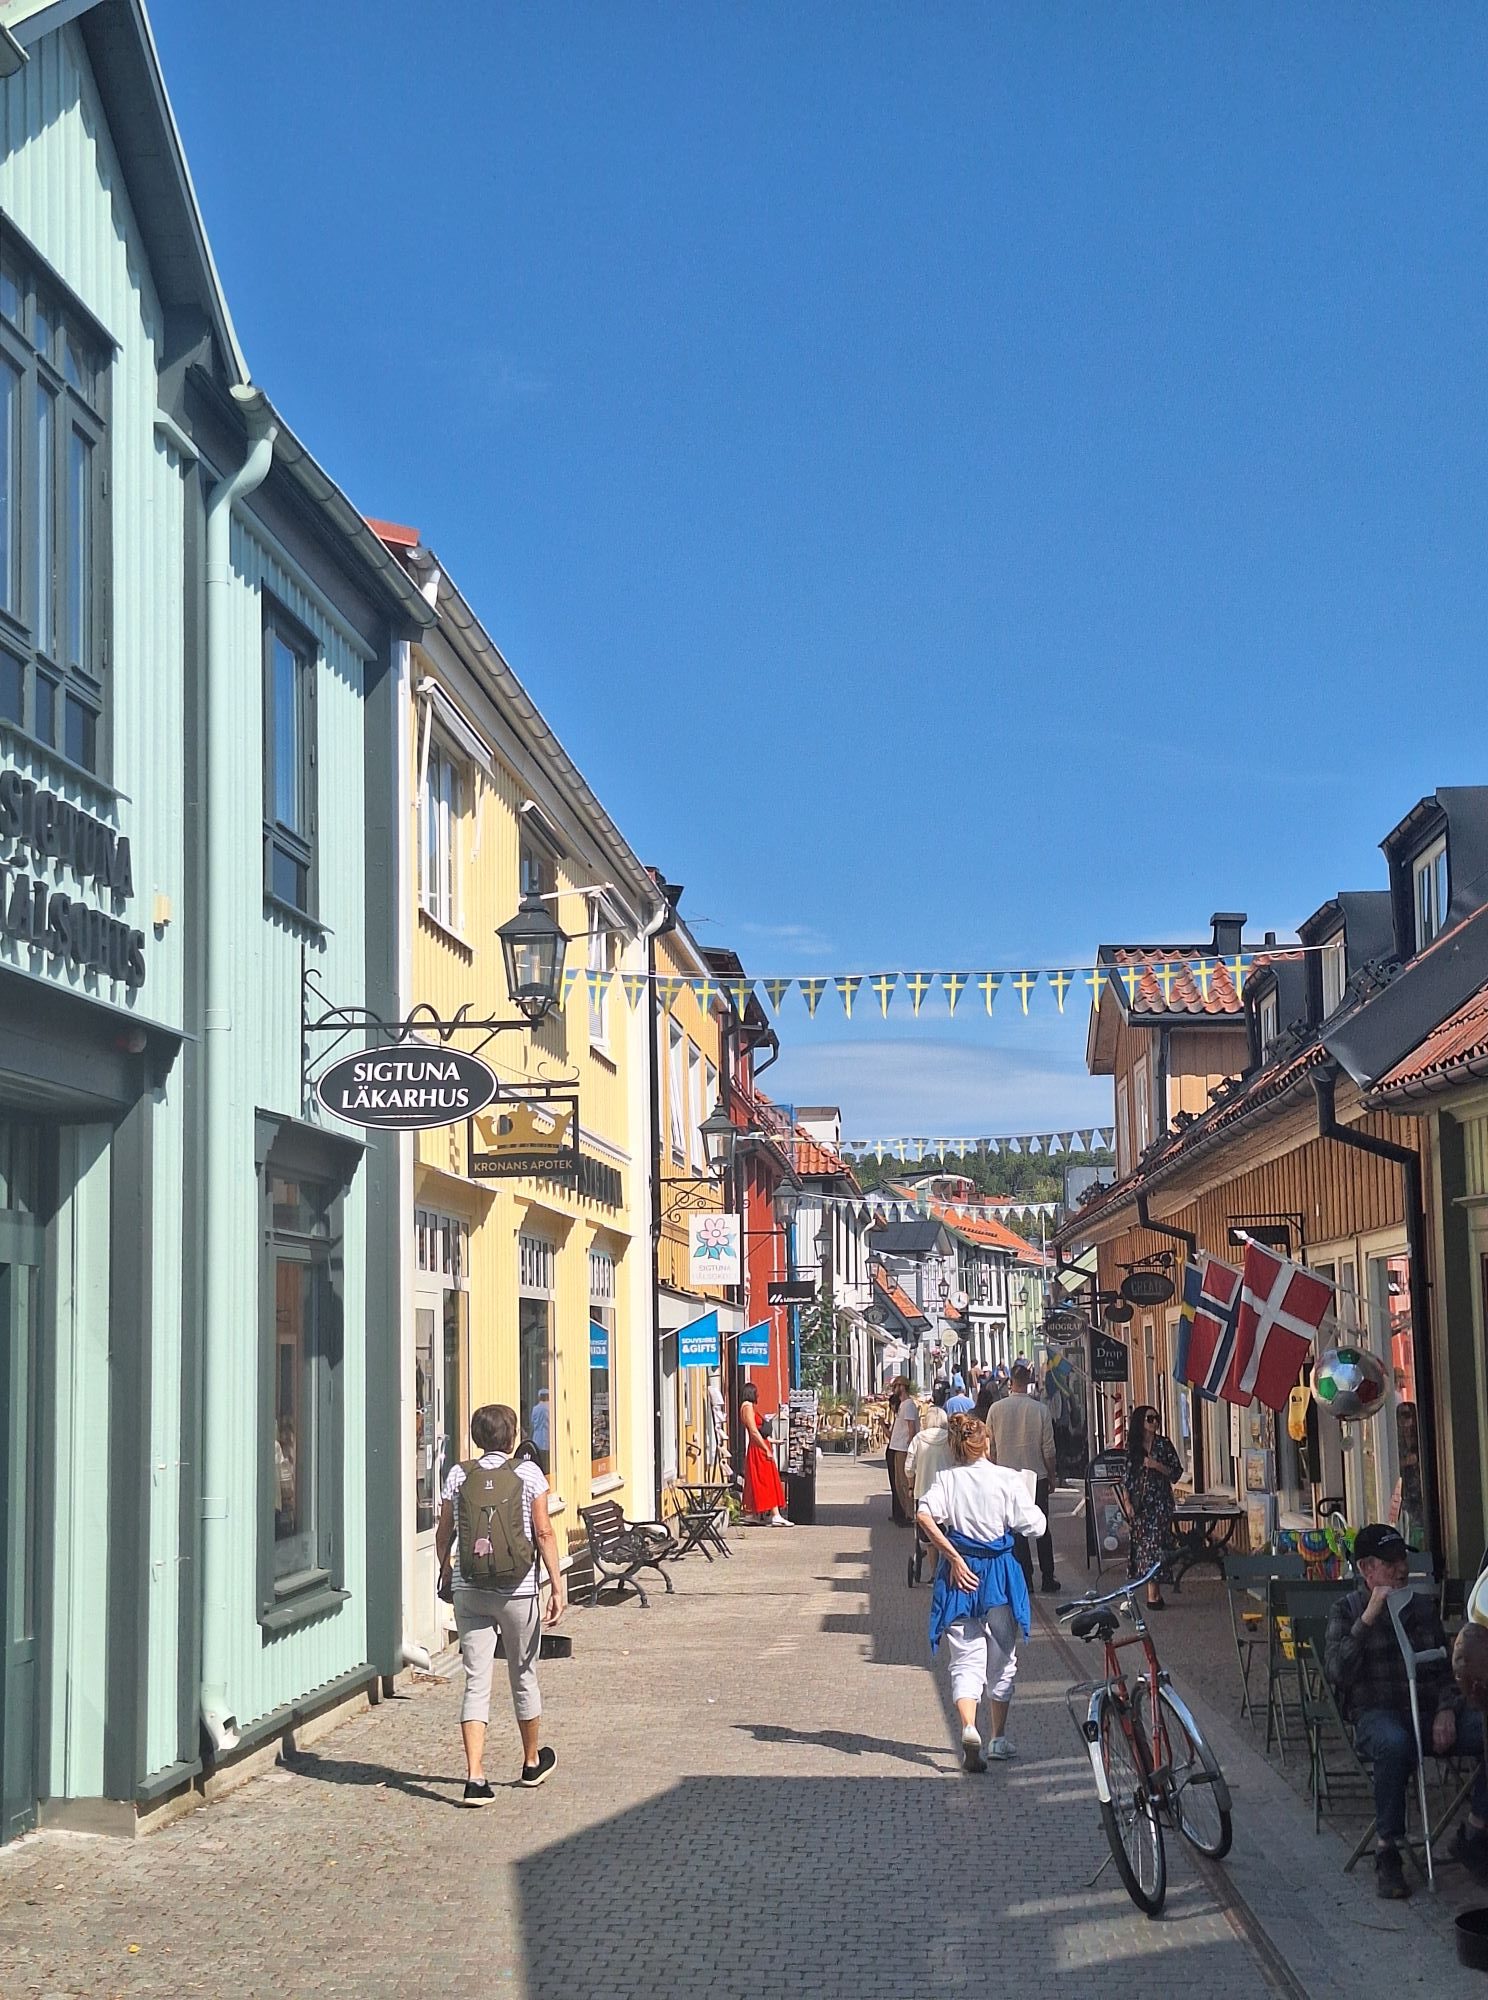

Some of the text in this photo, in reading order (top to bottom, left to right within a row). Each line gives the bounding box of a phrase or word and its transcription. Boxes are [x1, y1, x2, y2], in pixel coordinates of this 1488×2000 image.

[0, 769, 134, 898] SIGTUNA
[353, 1062, 461, 1082] SIGTUNA
[341, 1085, 469, 1109] LÄKARHUS
[473, 1159, 573, 1172] KRONANS APOTEK
[698, 1264, 731, 1272] SIGTUNA
[681, 1344, 717, 1354] &GIFTS
[740, 1347, 768, 1355] &GIFTS
[1096, 1348, 1123, 1360] Drop
[1104, 1358, 1114, 1367] in
